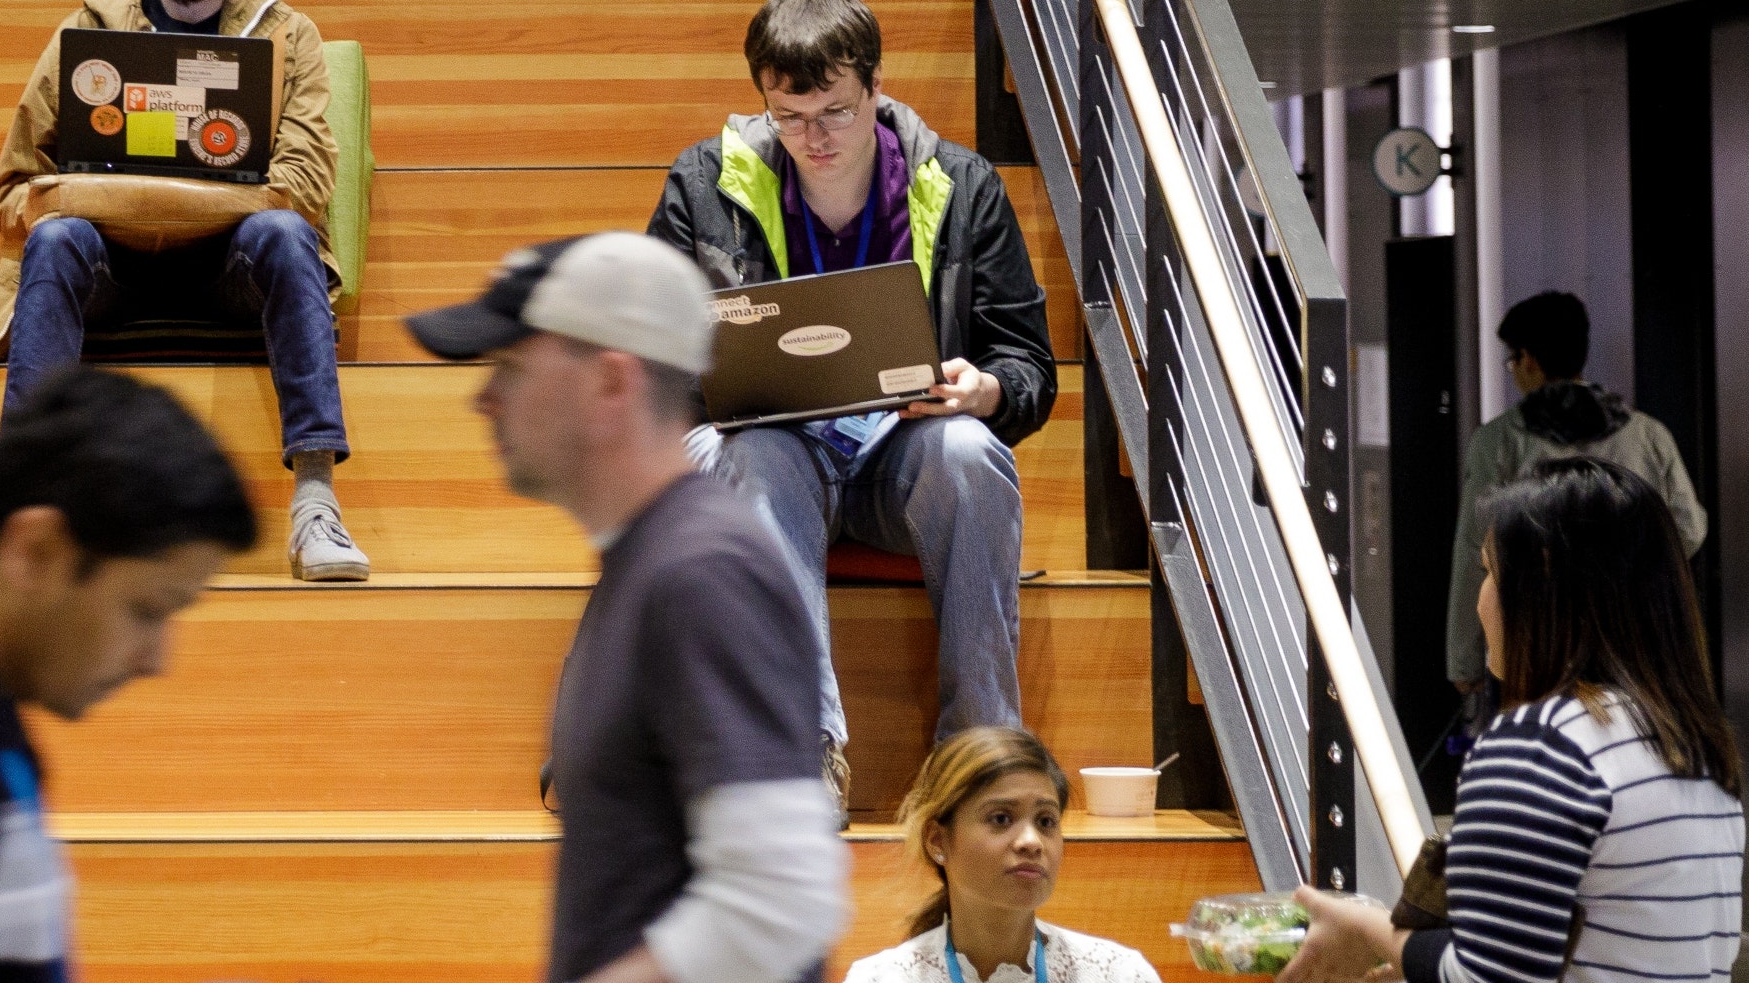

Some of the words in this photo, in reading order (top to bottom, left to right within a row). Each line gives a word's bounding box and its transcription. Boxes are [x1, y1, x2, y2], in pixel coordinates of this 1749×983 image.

[149, 89, 173, 99] aws
[149, 100, 204, 113] platform
[1395, 143, 1423, 177] K
[721, 304, 778, 320] amazon
[782, 331, 846, 346] sustainability
